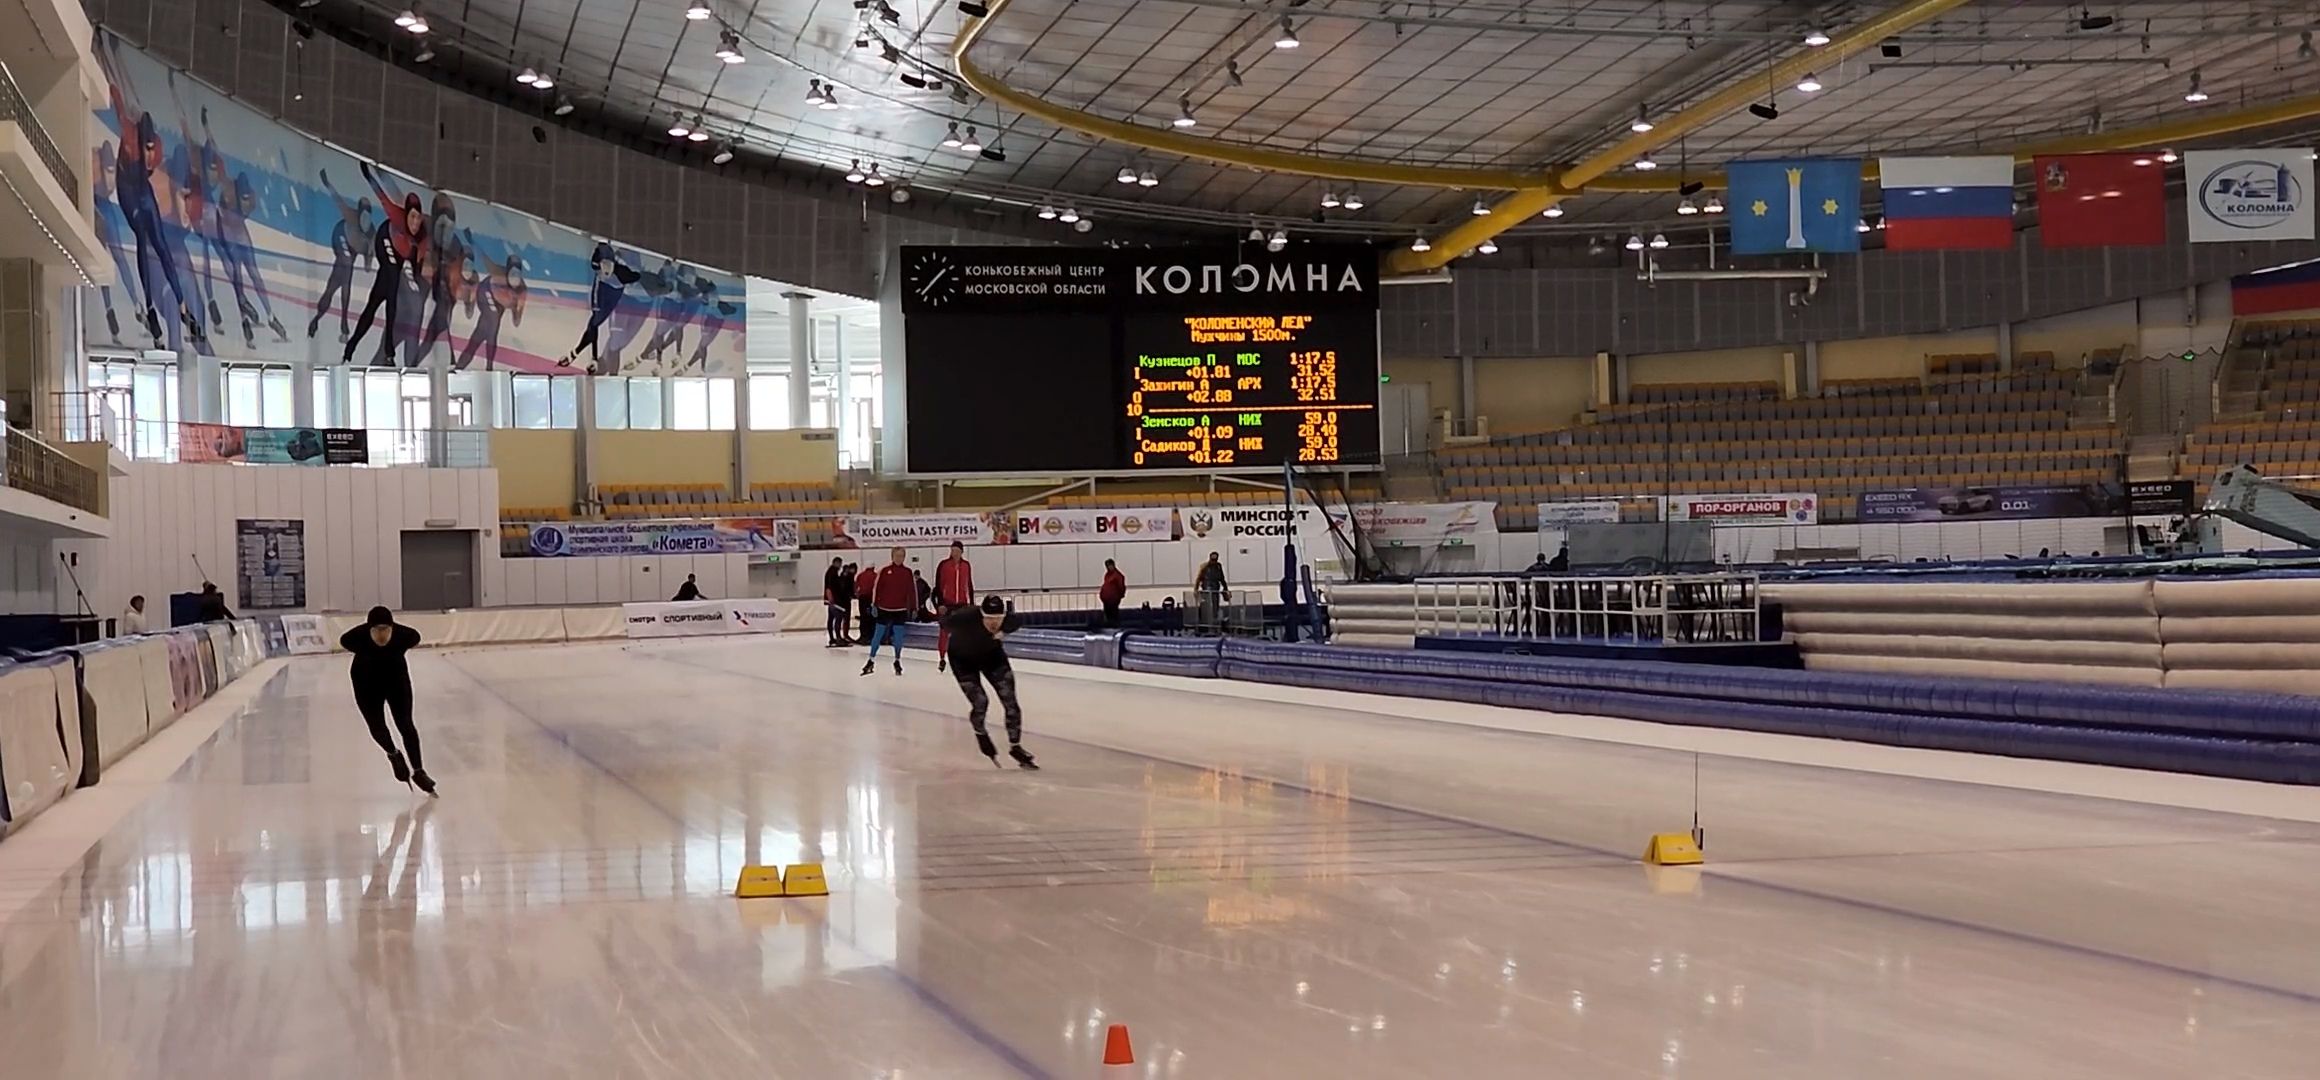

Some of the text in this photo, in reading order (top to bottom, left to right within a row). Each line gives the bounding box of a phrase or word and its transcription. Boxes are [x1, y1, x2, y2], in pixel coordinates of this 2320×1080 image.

[2227, 204, 2295, 213] КОЛОМНА
[965, 264, 1105, 277] КОНЬКОБЕЖНЫЙ ЦЕНТР
[1135, 263, 1363, 294] КОЛОМНА
[965, 282, 1106, 294] МОСКОВСКОЙ ОБЛАСТИ
[1139, 355, 1201, 367] Кузнецов
[1237, 353, 1261, 366] МОС
[1290, 351, 1335, 365] 1:17.5
[1297, 364, 1335, 376] 31.52
[1291, 376, 1336, 389] 1:17.5
[1297, 388, 1336, 401] 32.51
[1127, 404, 1142, 416] 10
[1305, 412, 1337, 424] 59.0
[1298, 424, 1337, 437] 28.40
[1141, 440, 1196, 452] Садиков
[1306, 436, 1337, 449] 59.0
[1299, 449, 1338, 462] 28.53
[1695, 502, 1782, 514] ПОР-ОРГАНОВ
[862, 525, 978, 538] KOLOMNA TASTY FISH
[1234, 525, 1297, 536] РОССИИ
[652, 535, 714, 550] «Комета»
[663, 611, 723, 623] СПОРТИВНЫЙ
